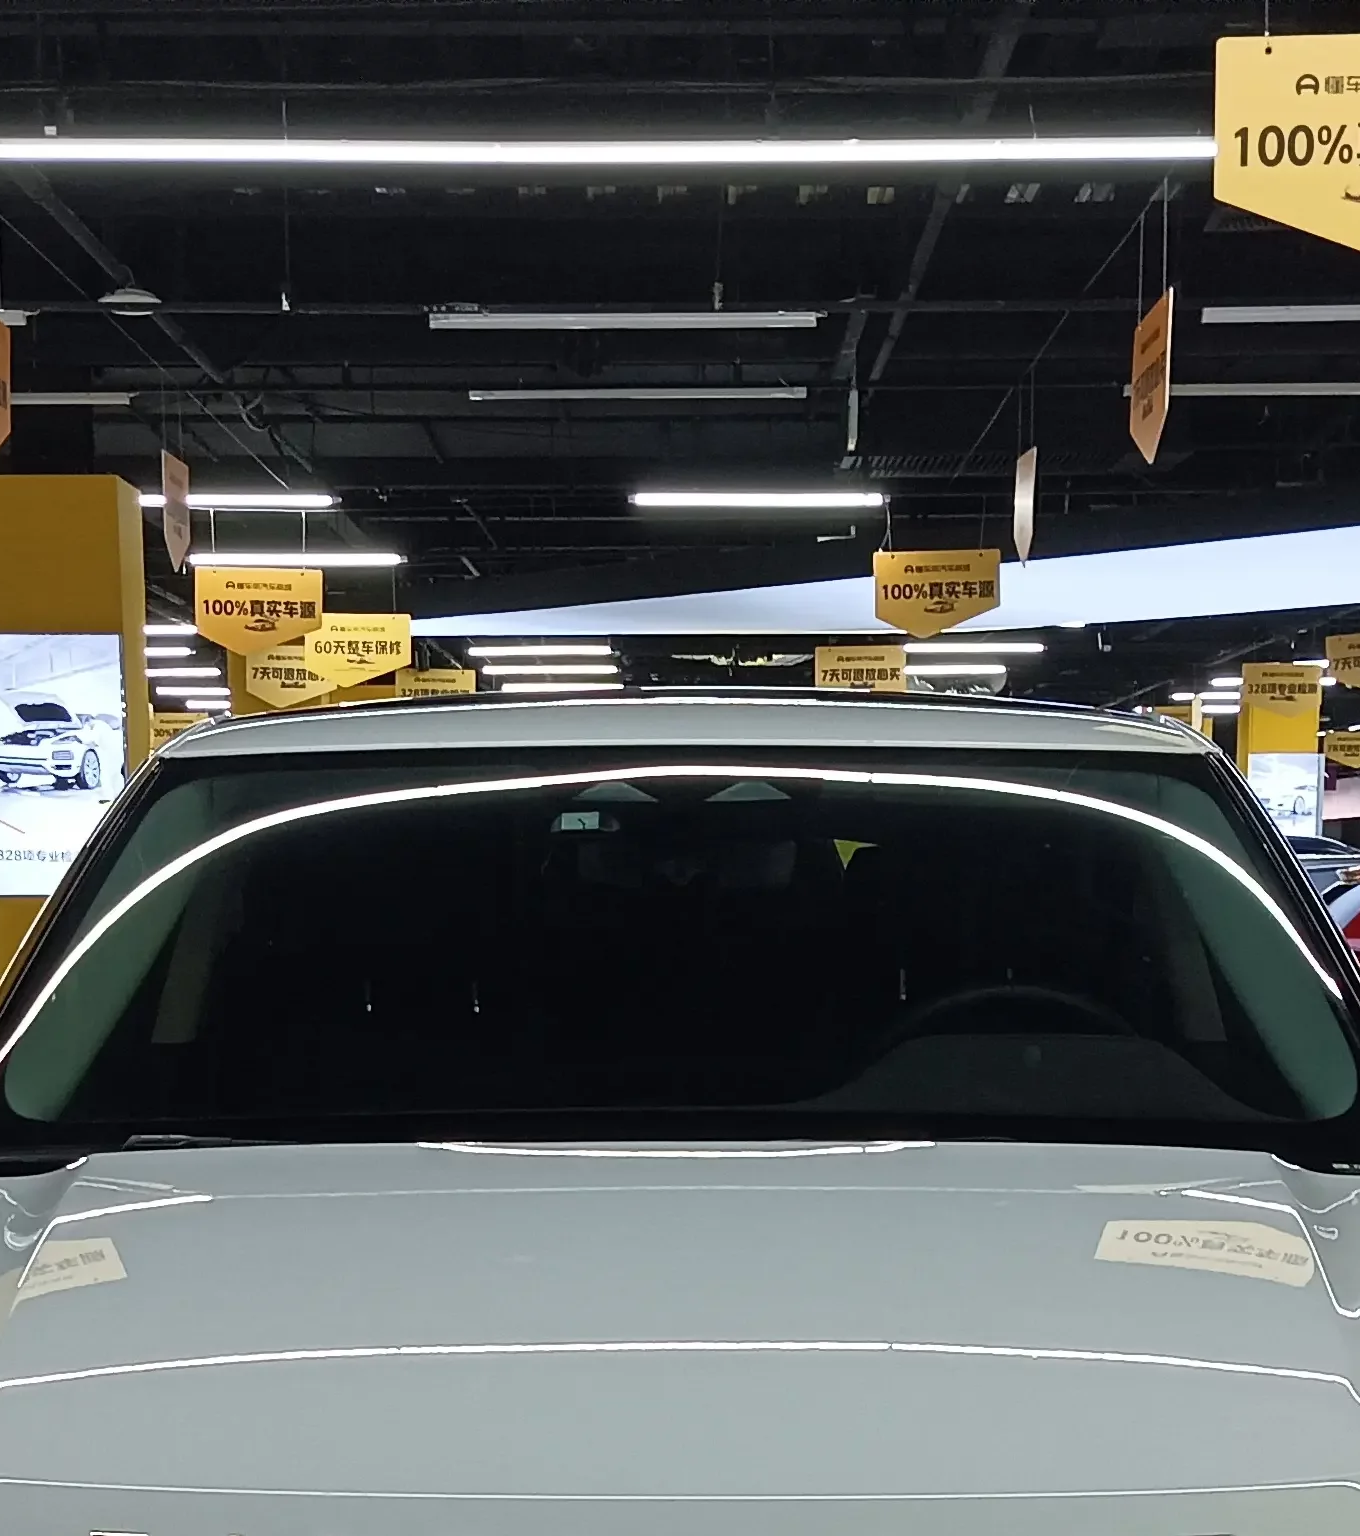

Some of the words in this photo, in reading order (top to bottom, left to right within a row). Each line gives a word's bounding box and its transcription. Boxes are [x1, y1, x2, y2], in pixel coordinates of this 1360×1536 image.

[252, 667, 327, 681] 7天可退放心
